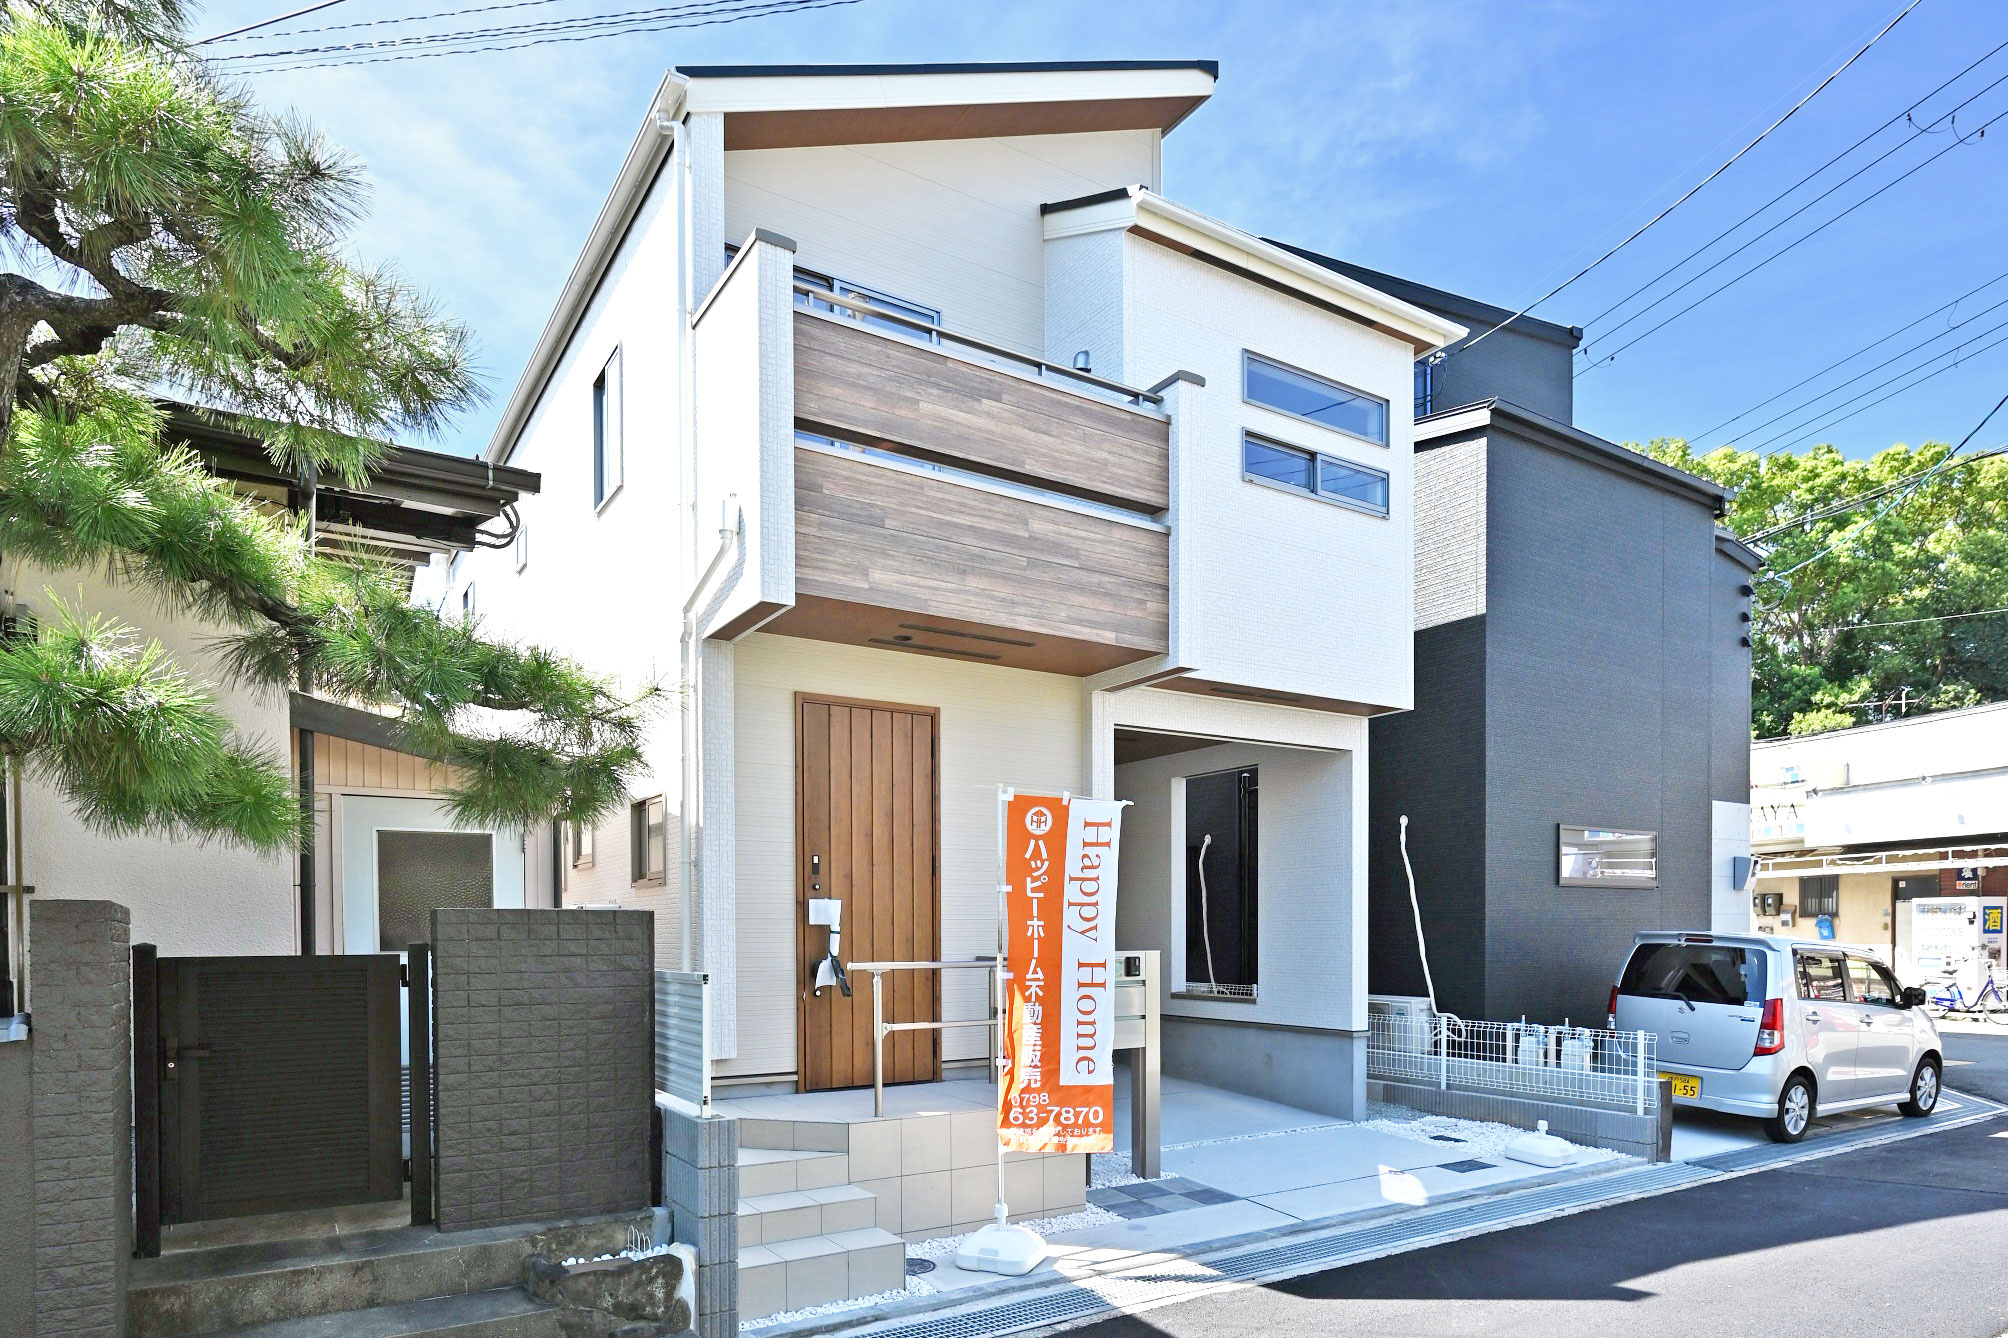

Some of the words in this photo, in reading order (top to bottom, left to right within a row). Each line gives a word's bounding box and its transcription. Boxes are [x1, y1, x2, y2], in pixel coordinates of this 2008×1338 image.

[1067, 818, 1112, 943] Happy
[1984, 908, 2001, 930] 酒
[1020, 839, 1049, 1088] ハッピーホーム不動産販売
[1076, 958, 1106, 1074] Home
[1009, 1106, 1104, 1125] 63-7870
[1011, 1092, 1049, 1106] 0798
